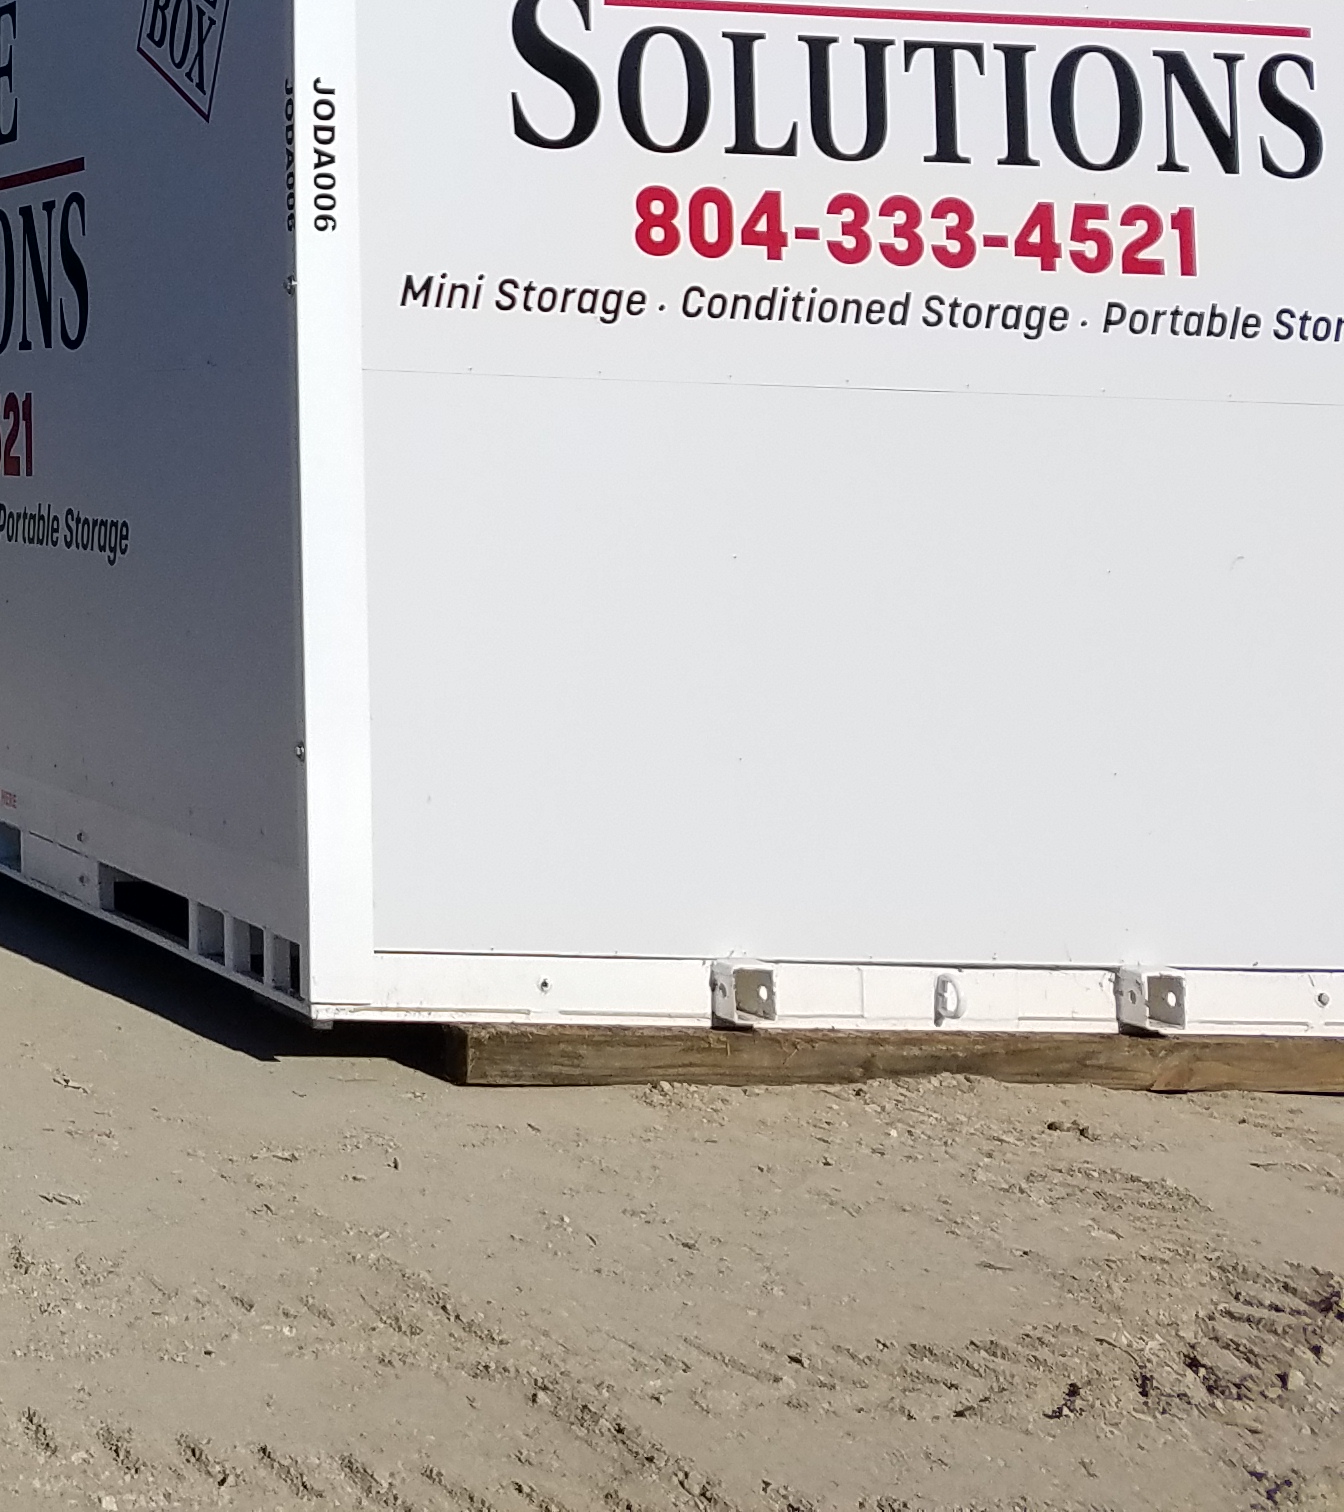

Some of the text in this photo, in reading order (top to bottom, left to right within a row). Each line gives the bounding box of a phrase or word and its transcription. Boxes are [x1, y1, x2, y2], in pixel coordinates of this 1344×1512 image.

[313, 76, 337, 232] JODA006
[635, 185, 1197, 277] 804-333-4521
[400, 271, 485, 310] Mini
[495, 278, 646, 325] Storage
[682, 285, 911, 326] Conditioned
[922, 295, 1069, 340] Storage
[1102, 301, 1261, 340] Portable
[64, 507, 130, 567] Storage
